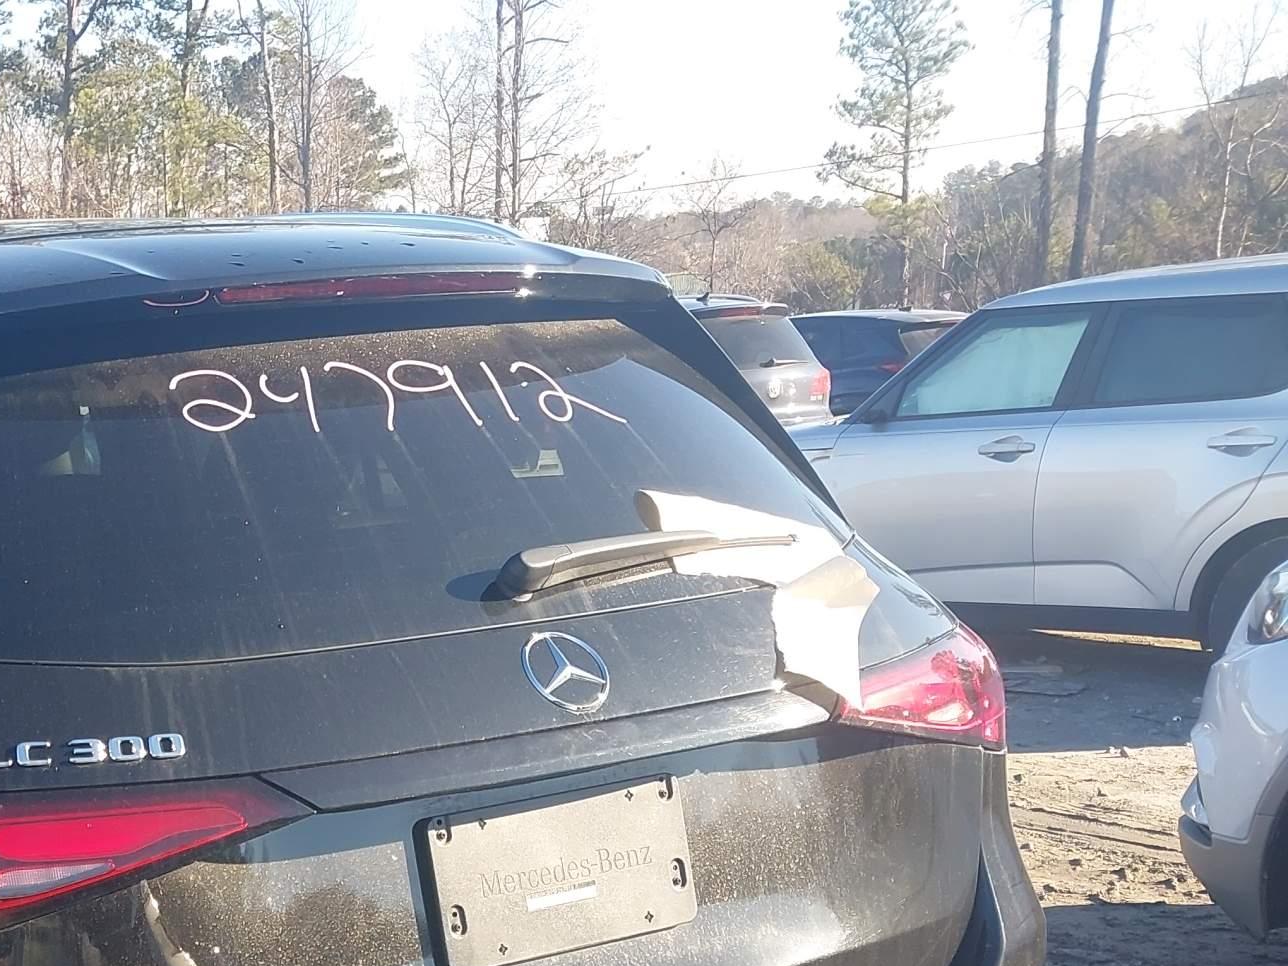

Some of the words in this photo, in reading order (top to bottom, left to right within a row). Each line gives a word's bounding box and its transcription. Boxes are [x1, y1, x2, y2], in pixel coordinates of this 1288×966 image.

[169, 359, 629, 433] 247912
[66, 732, 187, 765] 300
[479, 845, 653, 899] Mercedes-Benz
